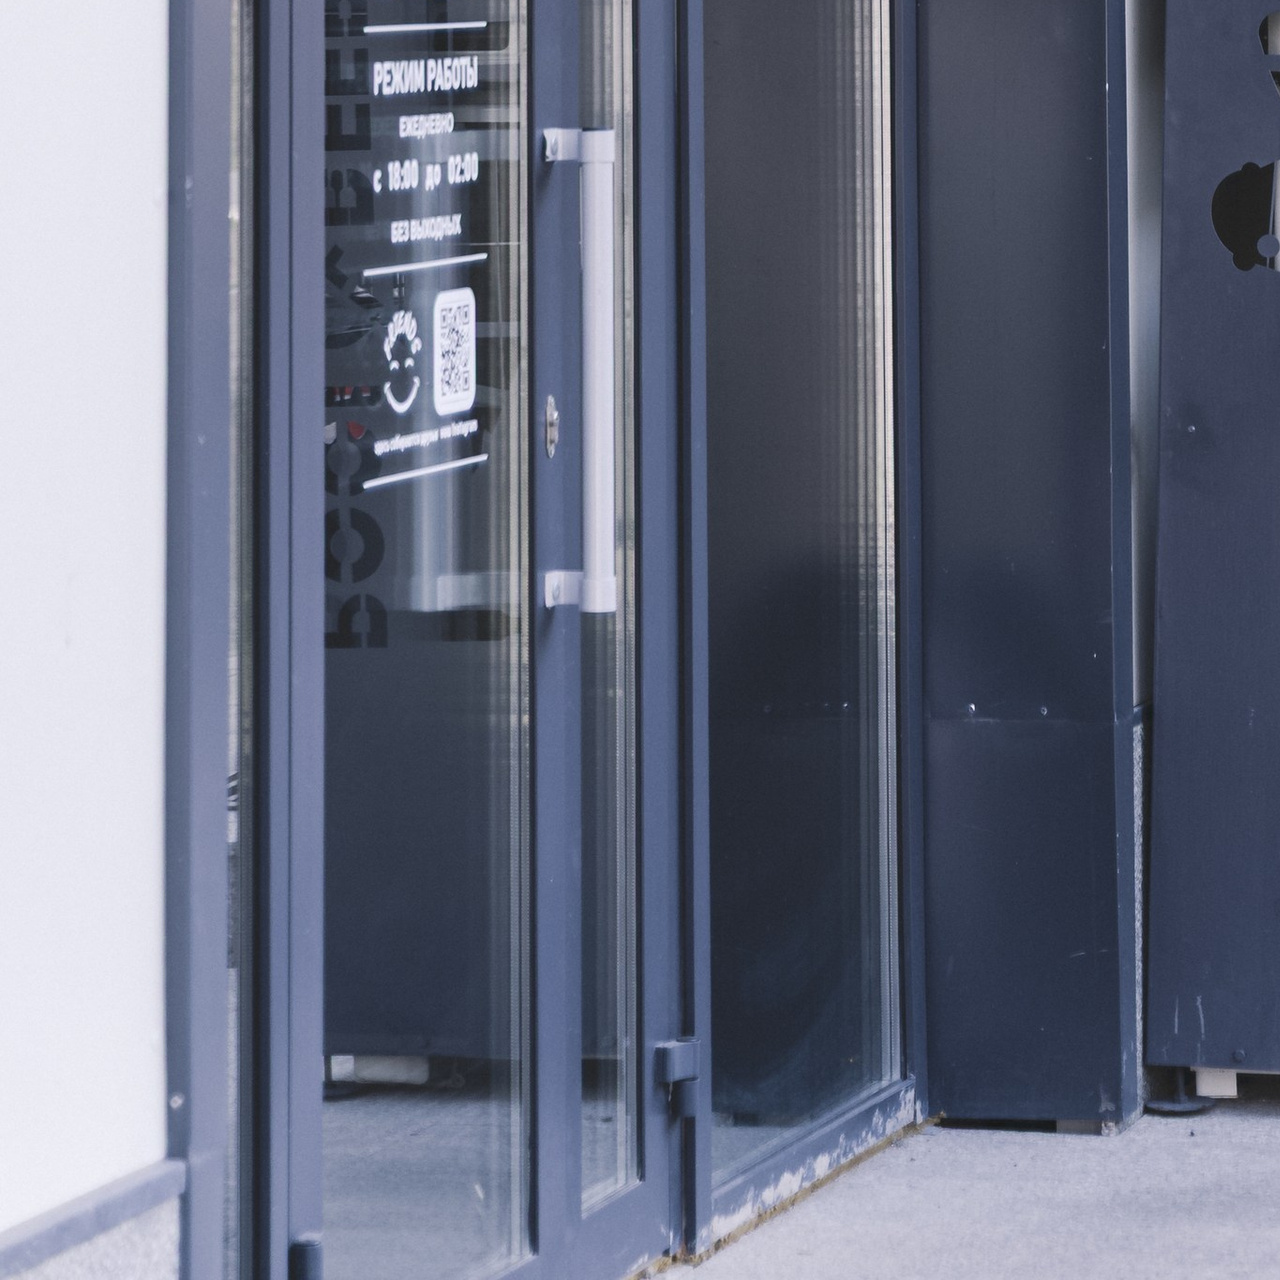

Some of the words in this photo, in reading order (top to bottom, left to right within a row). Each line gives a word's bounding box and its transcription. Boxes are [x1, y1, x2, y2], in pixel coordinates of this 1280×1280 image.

[373, 59, 425, 96] РЕЖИМ
[427, 55, 479, 92] РАБОТЫ
[399, 111, 454, 140] ЕЖЕДНЕВНО
[388, 158, 419, 191] 18:00
[425, 163, 441, 191] до
[448, 151, 479, 185] 02:00
[390, 220, 410, 244] БЕЗ
[410, 213, 462, 242] ВЫХОДНЫХ
